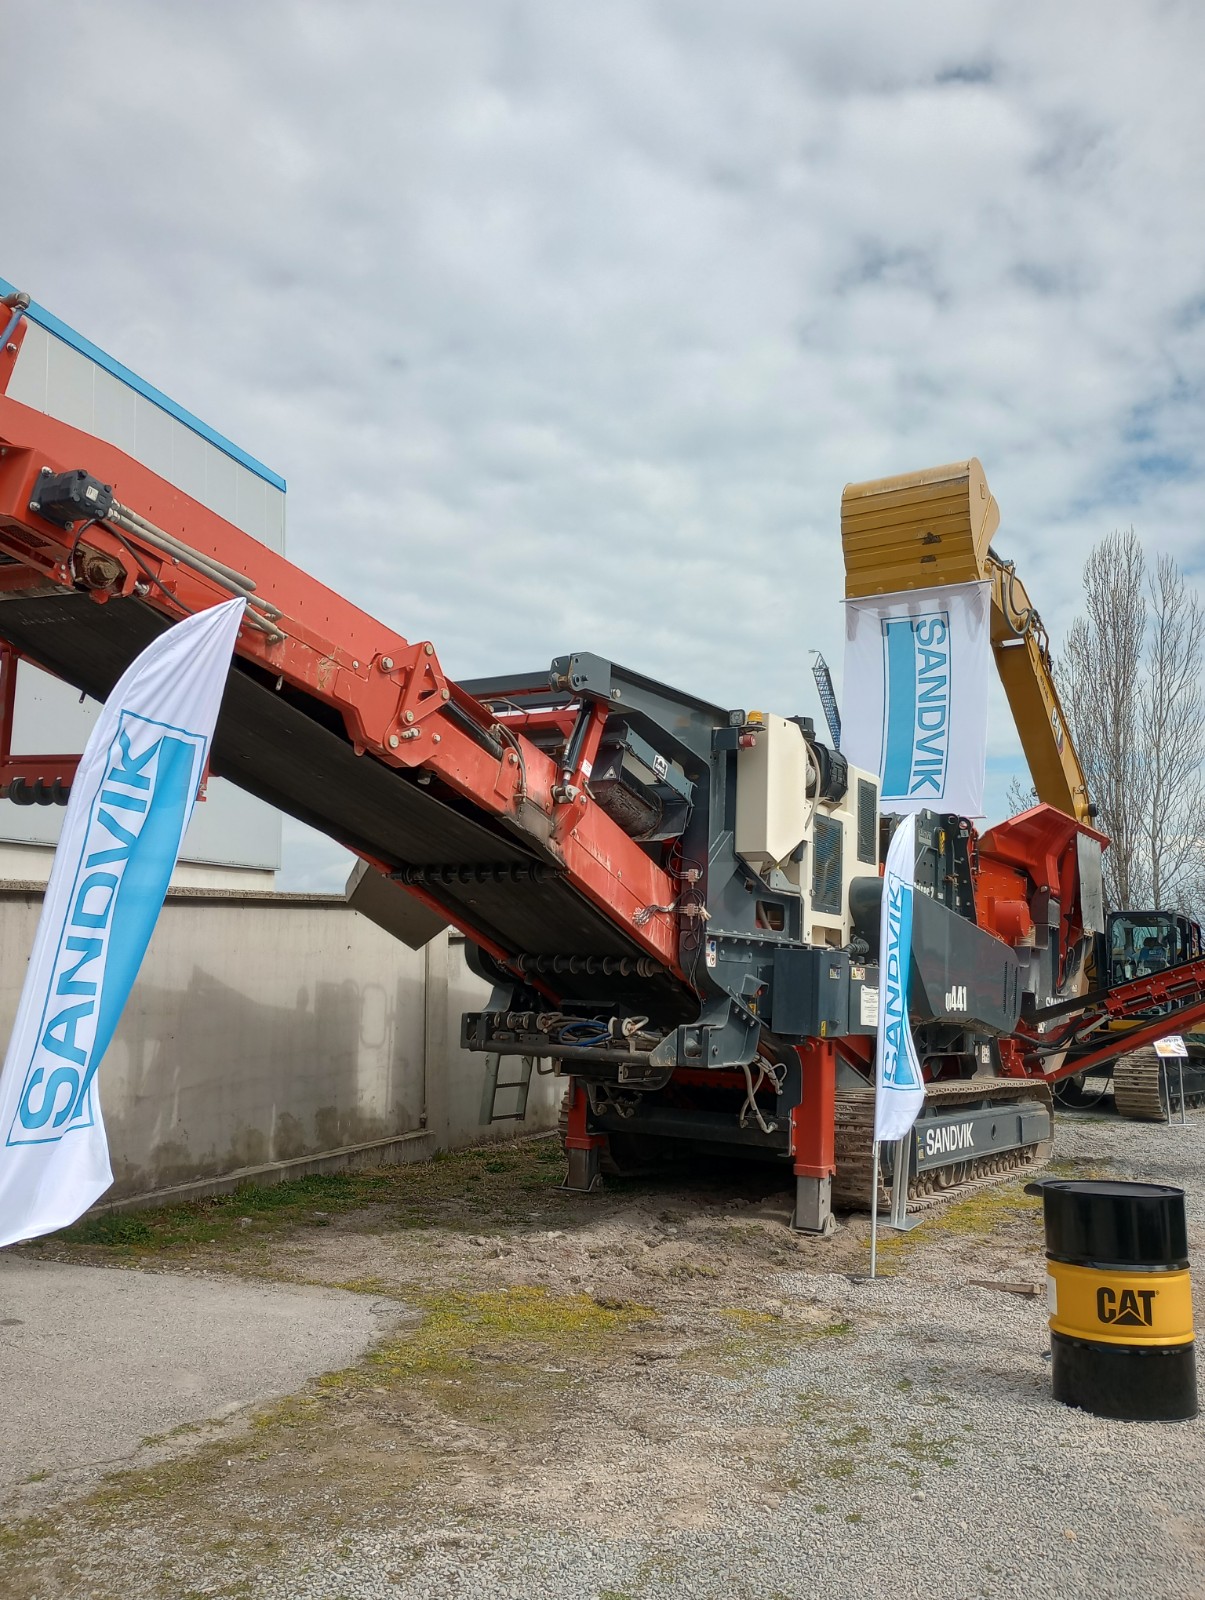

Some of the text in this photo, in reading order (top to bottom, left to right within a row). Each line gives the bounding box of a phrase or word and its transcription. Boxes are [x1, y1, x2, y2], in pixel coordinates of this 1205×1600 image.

[910, 618, 947, 796] SANDVIK
[20, 728, 162, 1129] SANDVIK
[884, 880, 902, 1083] SANDVIK
[926, 1122, 974, 1156] SANDVIK
[1097, 1287, 1155, 1326] CAT
